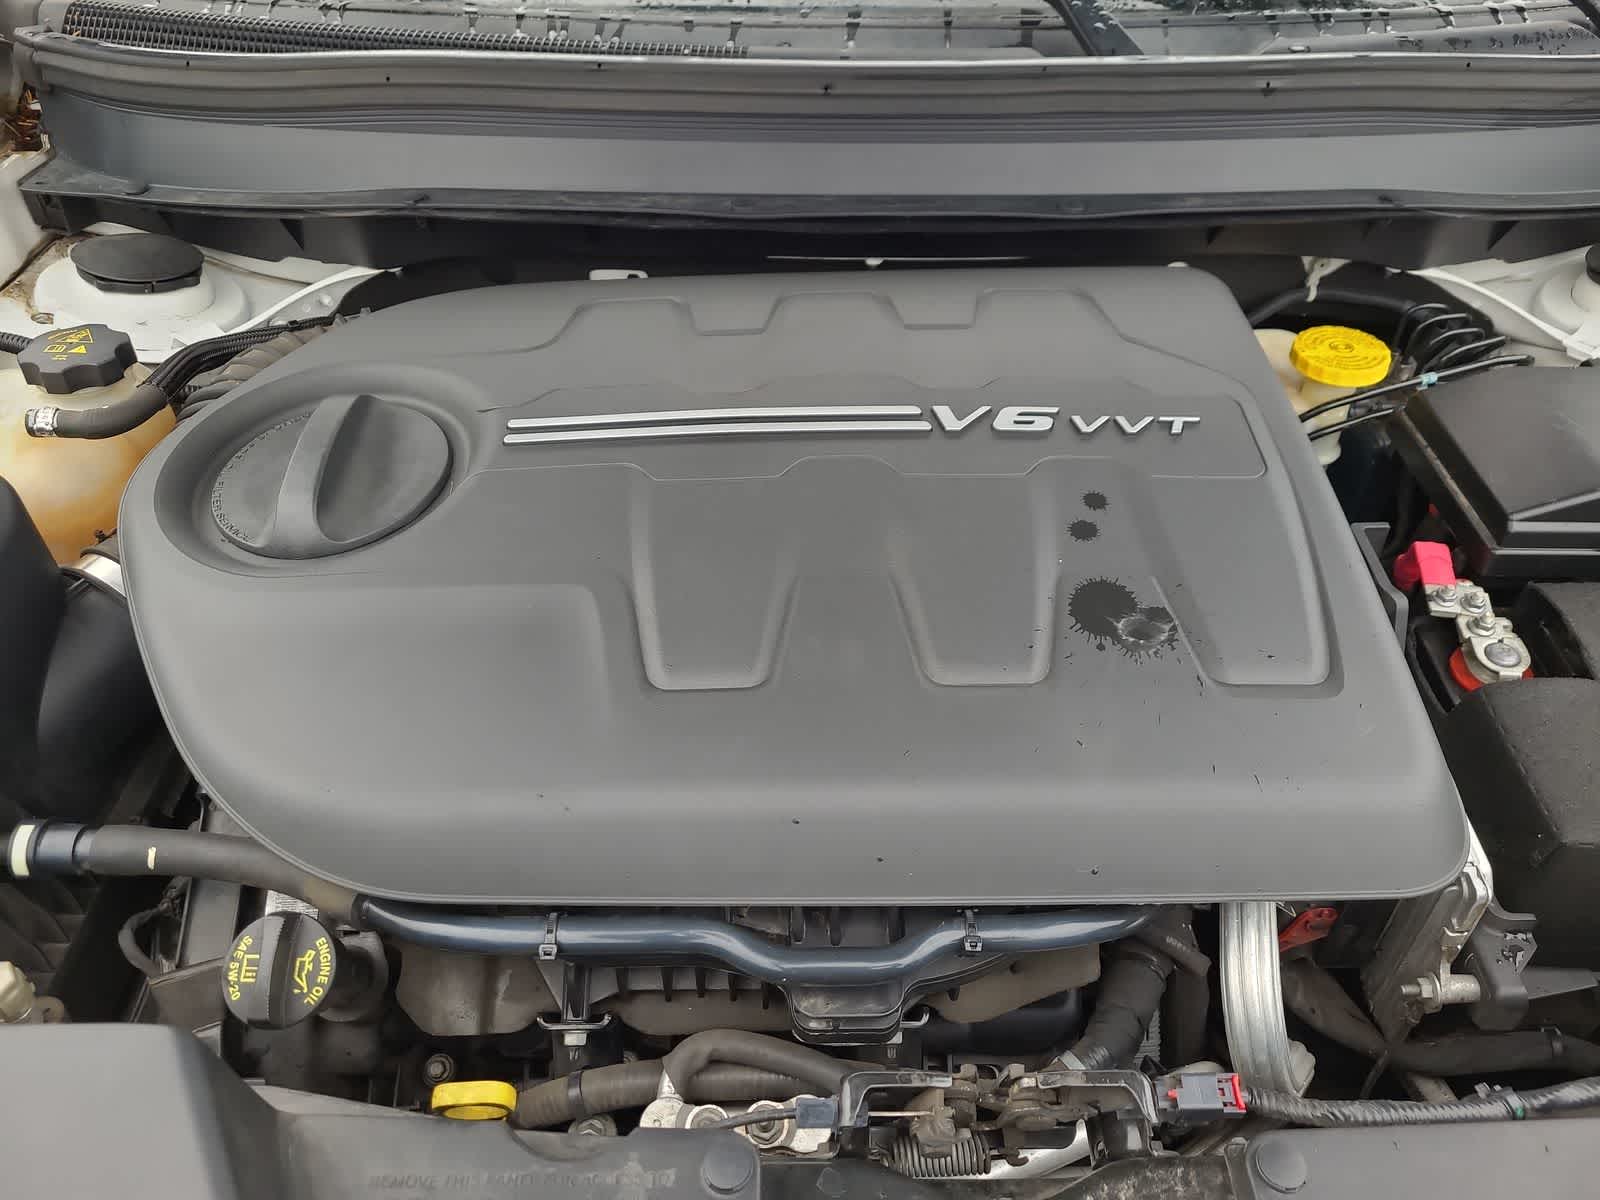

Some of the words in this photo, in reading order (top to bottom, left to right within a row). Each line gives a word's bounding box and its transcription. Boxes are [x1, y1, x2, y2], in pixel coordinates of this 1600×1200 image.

[932, 405, 1060, 431] V6
[1069, 415, 1200, 434] VVT
[233, 935, 254, 960] SAE
[315, 936, 332, 985] ENGINE
[227, 961, 241, 1001] 5W-20
[303, 986, 324, 1006] OIL
